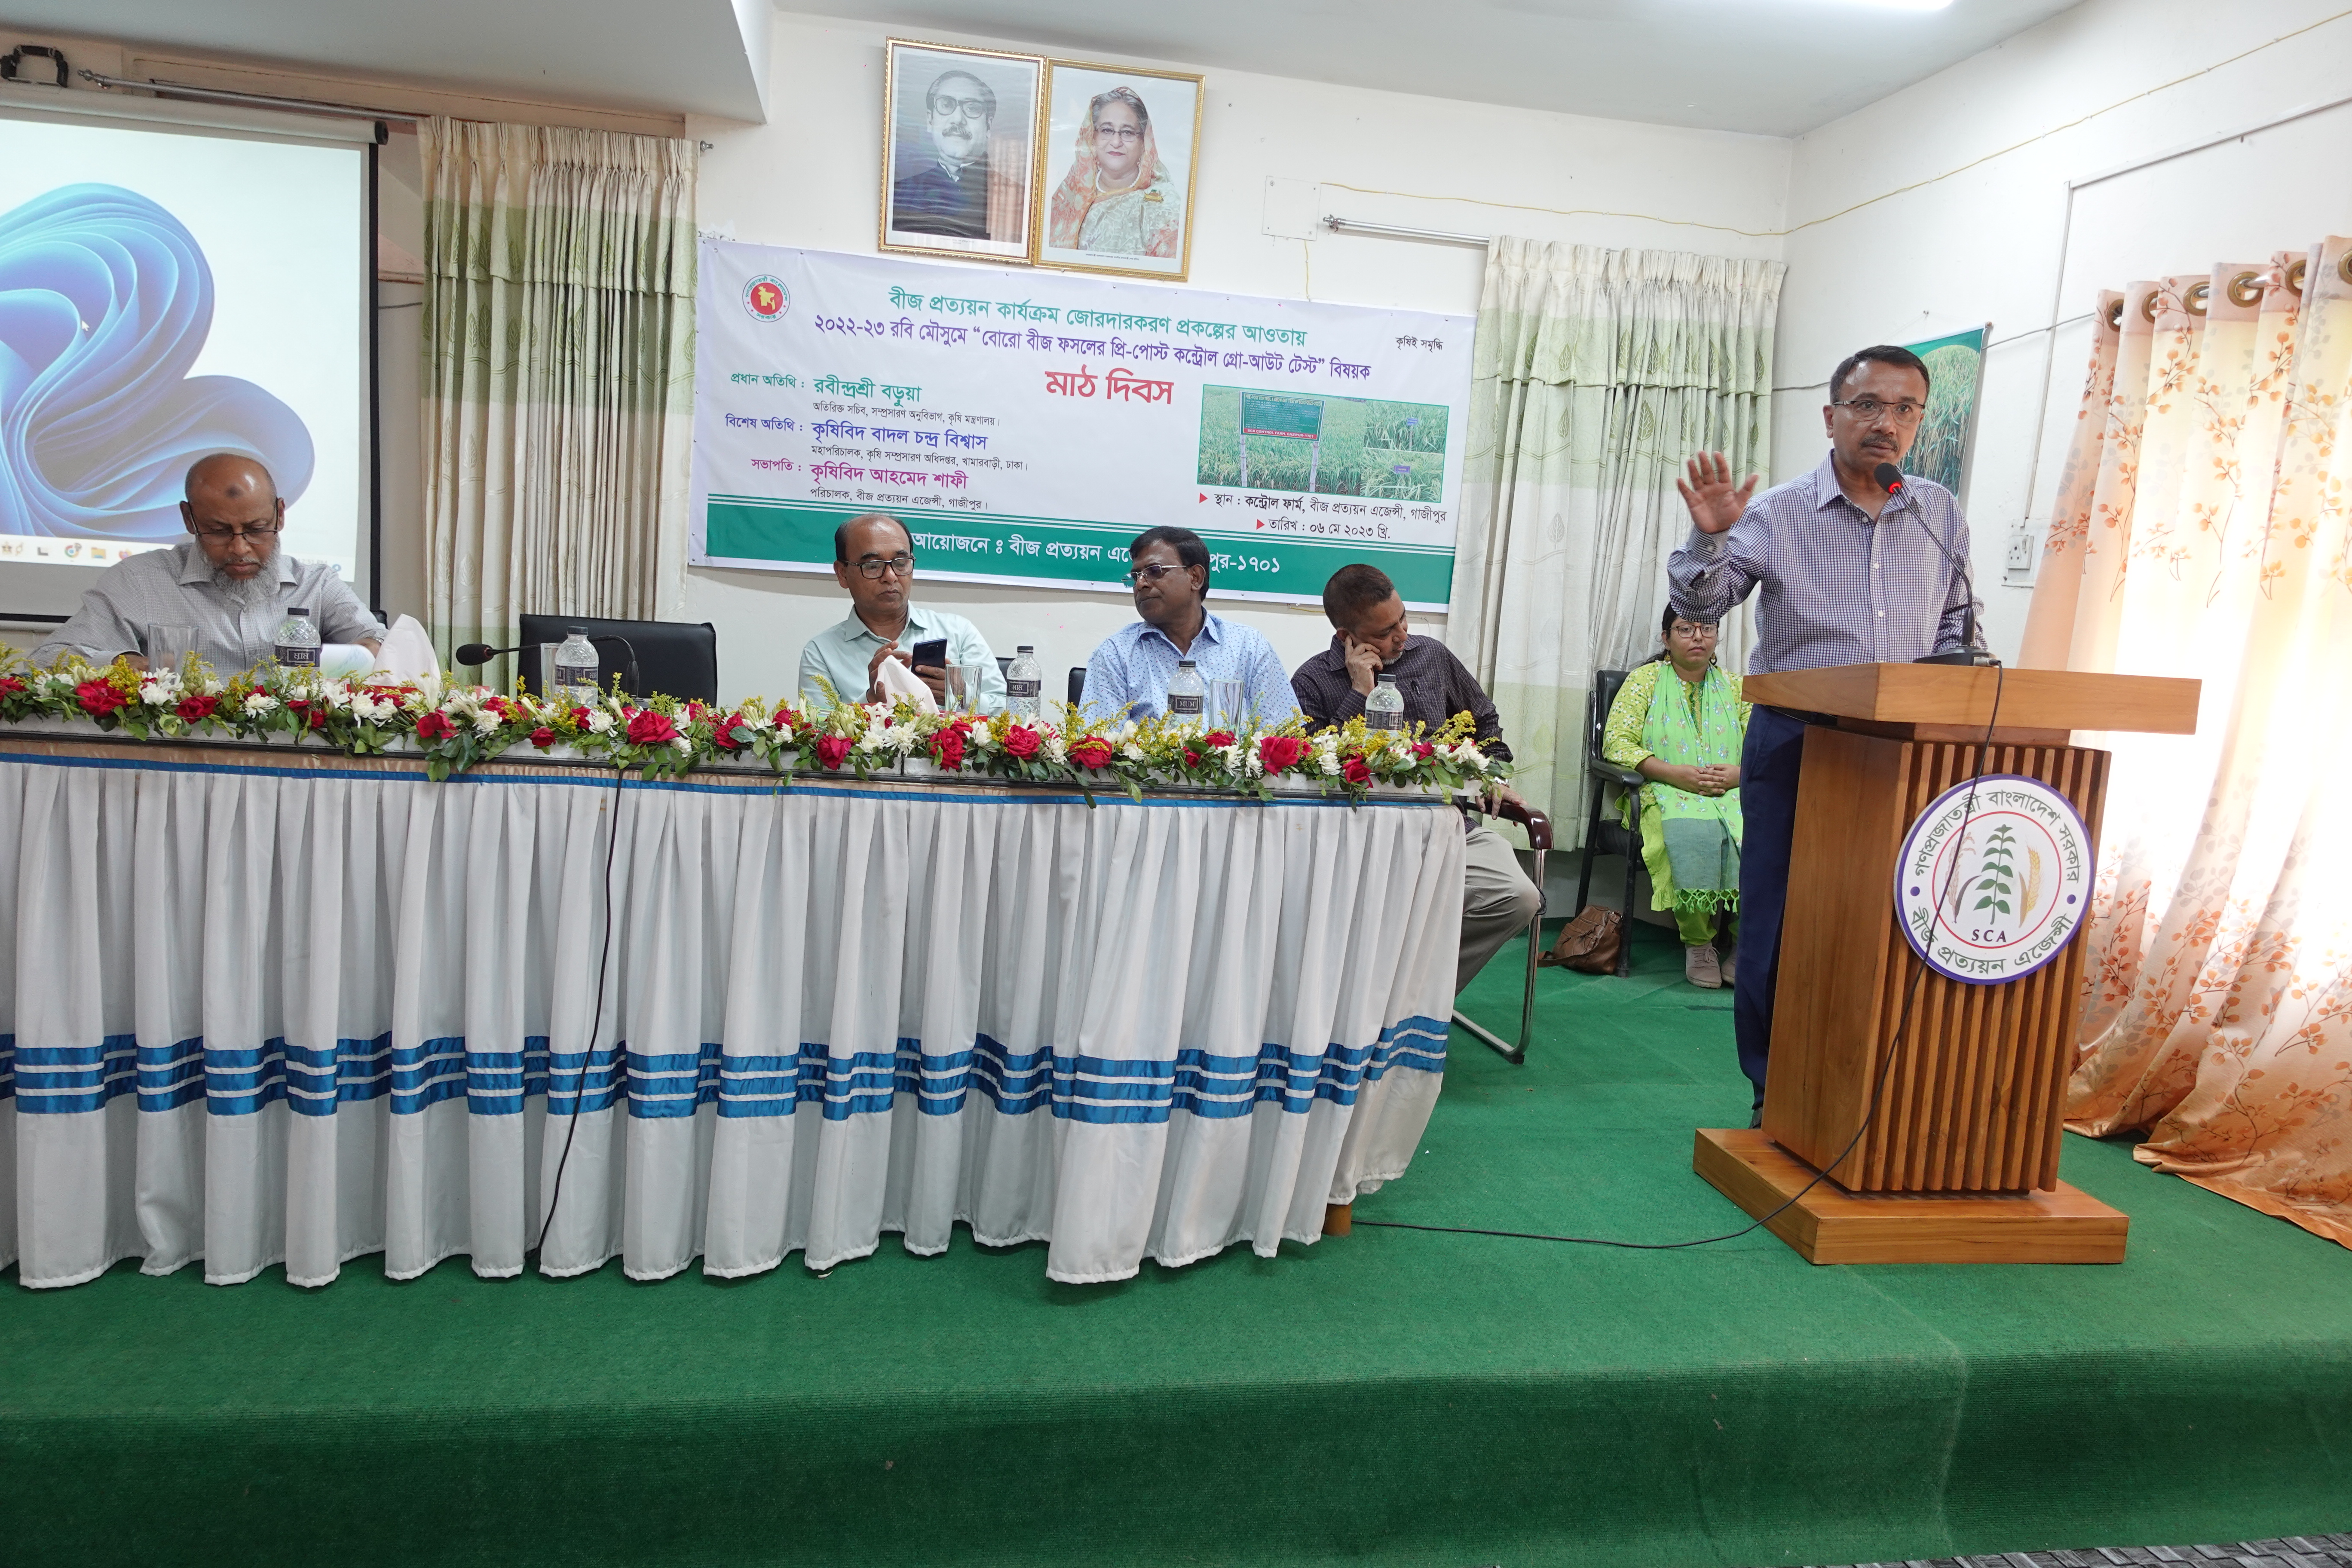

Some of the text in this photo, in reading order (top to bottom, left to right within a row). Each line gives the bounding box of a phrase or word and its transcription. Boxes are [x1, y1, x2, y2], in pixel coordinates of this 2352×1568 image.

[888, 286, 1308, 346] বীজ প্রত্যয়ন কার্যক্রম জোরদারকরণ প্রকল্পের আওতায়
[815, 315, 884, 337] ২০২২-২৩
[890, 317, 914, 339] রবি
[919, 319, 968, 347] মৌসুমে
[1026, 328, 1054, 352] বীজ
[1057, 337, 1106, 355] ফসলের
[1110, 337, 1170, 361] প্রি-পোস্ট
[1173, 344, 1219, 368] কন্ট্রোল
[1223, 351, 1284, 371] গ্রো-আউট
[1329, 357, 1371, 380] বিষয়ক
[1396, 335, 1443, 352] কৃষিই সমৃদ্ধি
[731, 373, 759, 384] প্রধান
[762, 373, 797, 388] অতিথি
[813, 374, 876, 398] রবীন্দ্রশ্রী
[880, 385, 922, 408] বড়ুয়া
[1045, 364, 1174, 404] মাঠ দিবস
[813, 401, 844, 412] অতিরিক্ত
[872, 408, 906, 418] সম্প্রসারণ
[949, 412, 962, 426] কৃষি
[965, 416, 995, 425] মন্ত্রণালয়
[725, 413, 757, 428] বিশেষ
[761, 417, 795, 431] অতিথি
[811, 420, 867, 443] কৃষিবিদ
[870, 427, 910, 444] বাদল
[914, 431, 940, 448] চন্দ্র
[944, 429, 988, 450] বিশ্বাস
[751, 458, 793, 471] সভাপতি
[809, 461, 865, 485] কৃষিবিদ
[869, 469, 928, 486] আহমেদ
[932, 470, 969, 489] শাফী
[867, 448, 882, 462] কৃষি
[885, 452, 921, 462] সম্প্রসারণ
[1006, 461, 1023, 470] ঢাকা
[856, 489, 873, 501] বীজ
[877, 494, 908, 503] প্রত্যয়ন
[949, 496, 982, 510] গাজীপুর
[1214, 494, 1233, 507] স্থান
[1244, 493, 1280, 510] কন্ট্রোল
[1310, 497, 1329, 512] বীজ
[1332, 503, 1367, 514] প্রত্যয়ন
[1411, 506, 1447, 524] গাজীপুর
[1268, 516, 1298, 530] তারিখ
[1310, 523, 1324, 533] ০৬
[1329, 524, 1341, 534] মে
[1344, 525, 1373, 537] ২০২৩
[910, 533, 990, 553] আয়োজনে
[1008, 534, 1041, 556] বীজ
[1046, 542, 1102, 560] প্রত্যয়ন
[1210, 553, 1279, 573] পুর-১৭০১
[1986, 790, 2061, 826] বাংলাদেশ
[2059, 823, 2081, 883] সরকার
[1911, 906, 2074, 974] বীজ প্রত্যয়ন এজেন্সী
